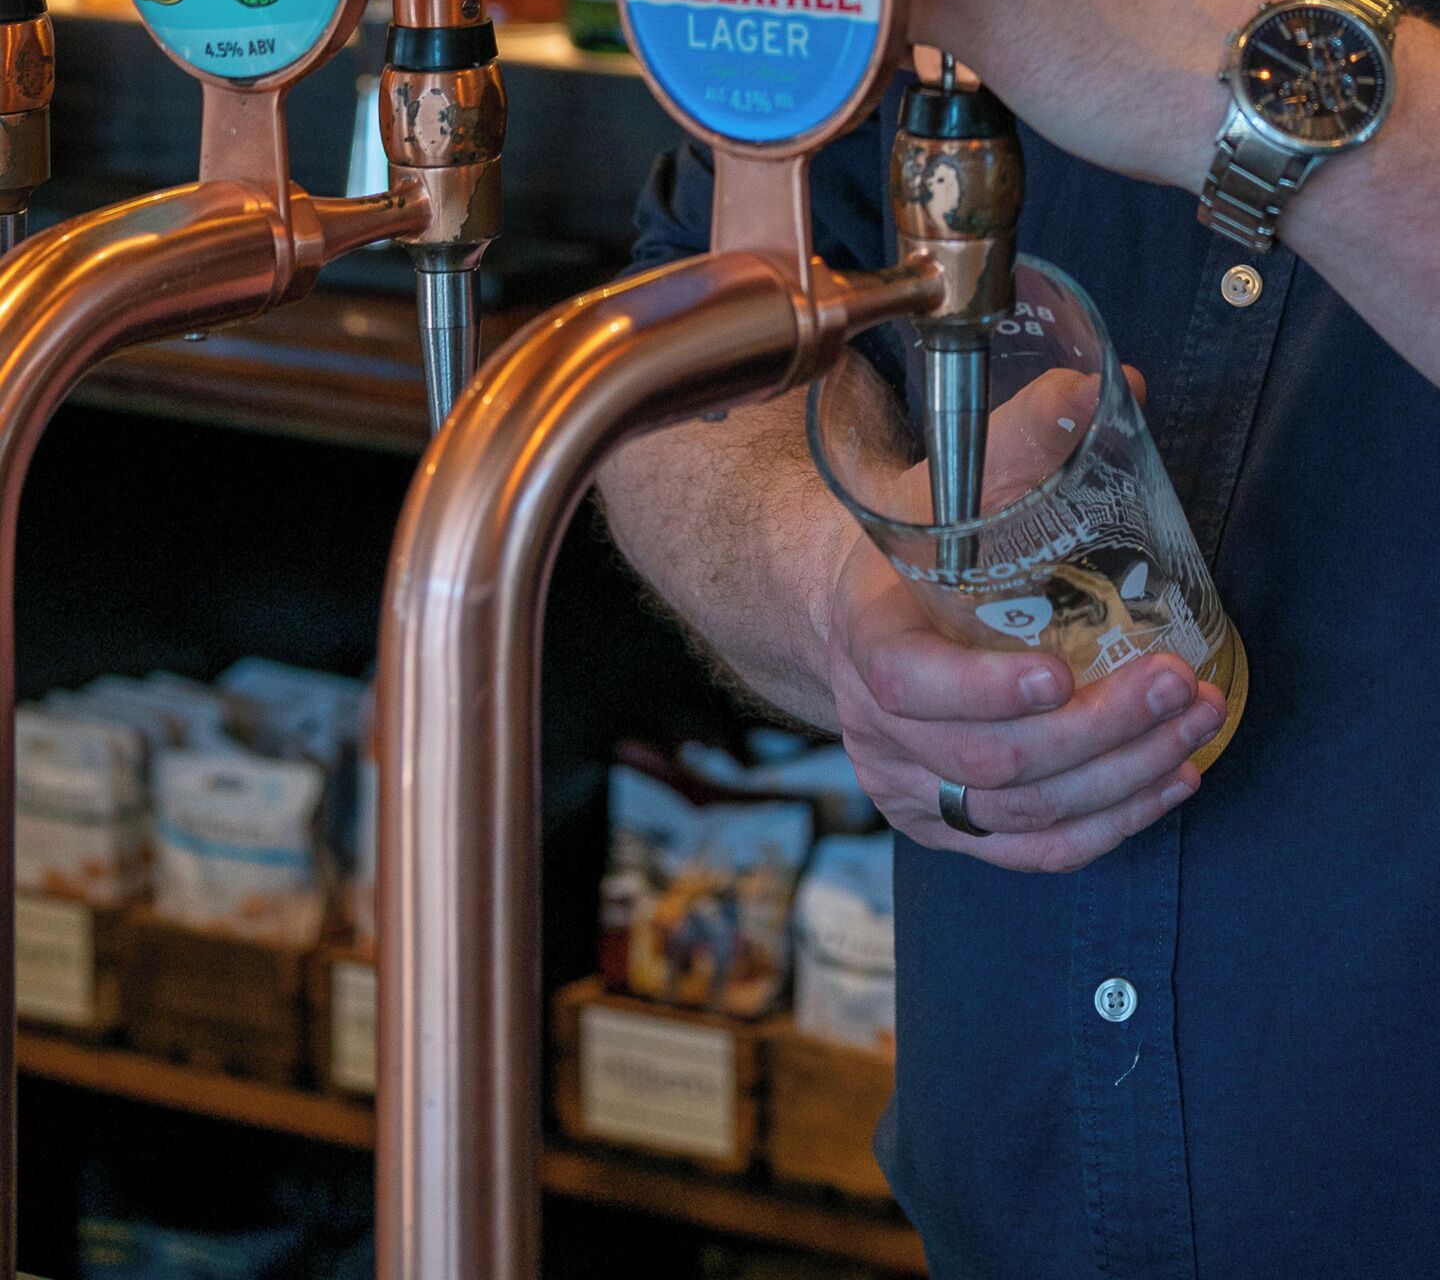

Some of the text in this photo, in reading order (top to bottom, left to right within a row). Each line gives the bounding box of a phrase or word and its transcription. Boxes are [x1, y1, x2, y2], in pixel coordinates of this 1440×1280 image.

[204, 38, 276, 59] 4.5% ABV
[686, 12, 810, 60] LAGER
